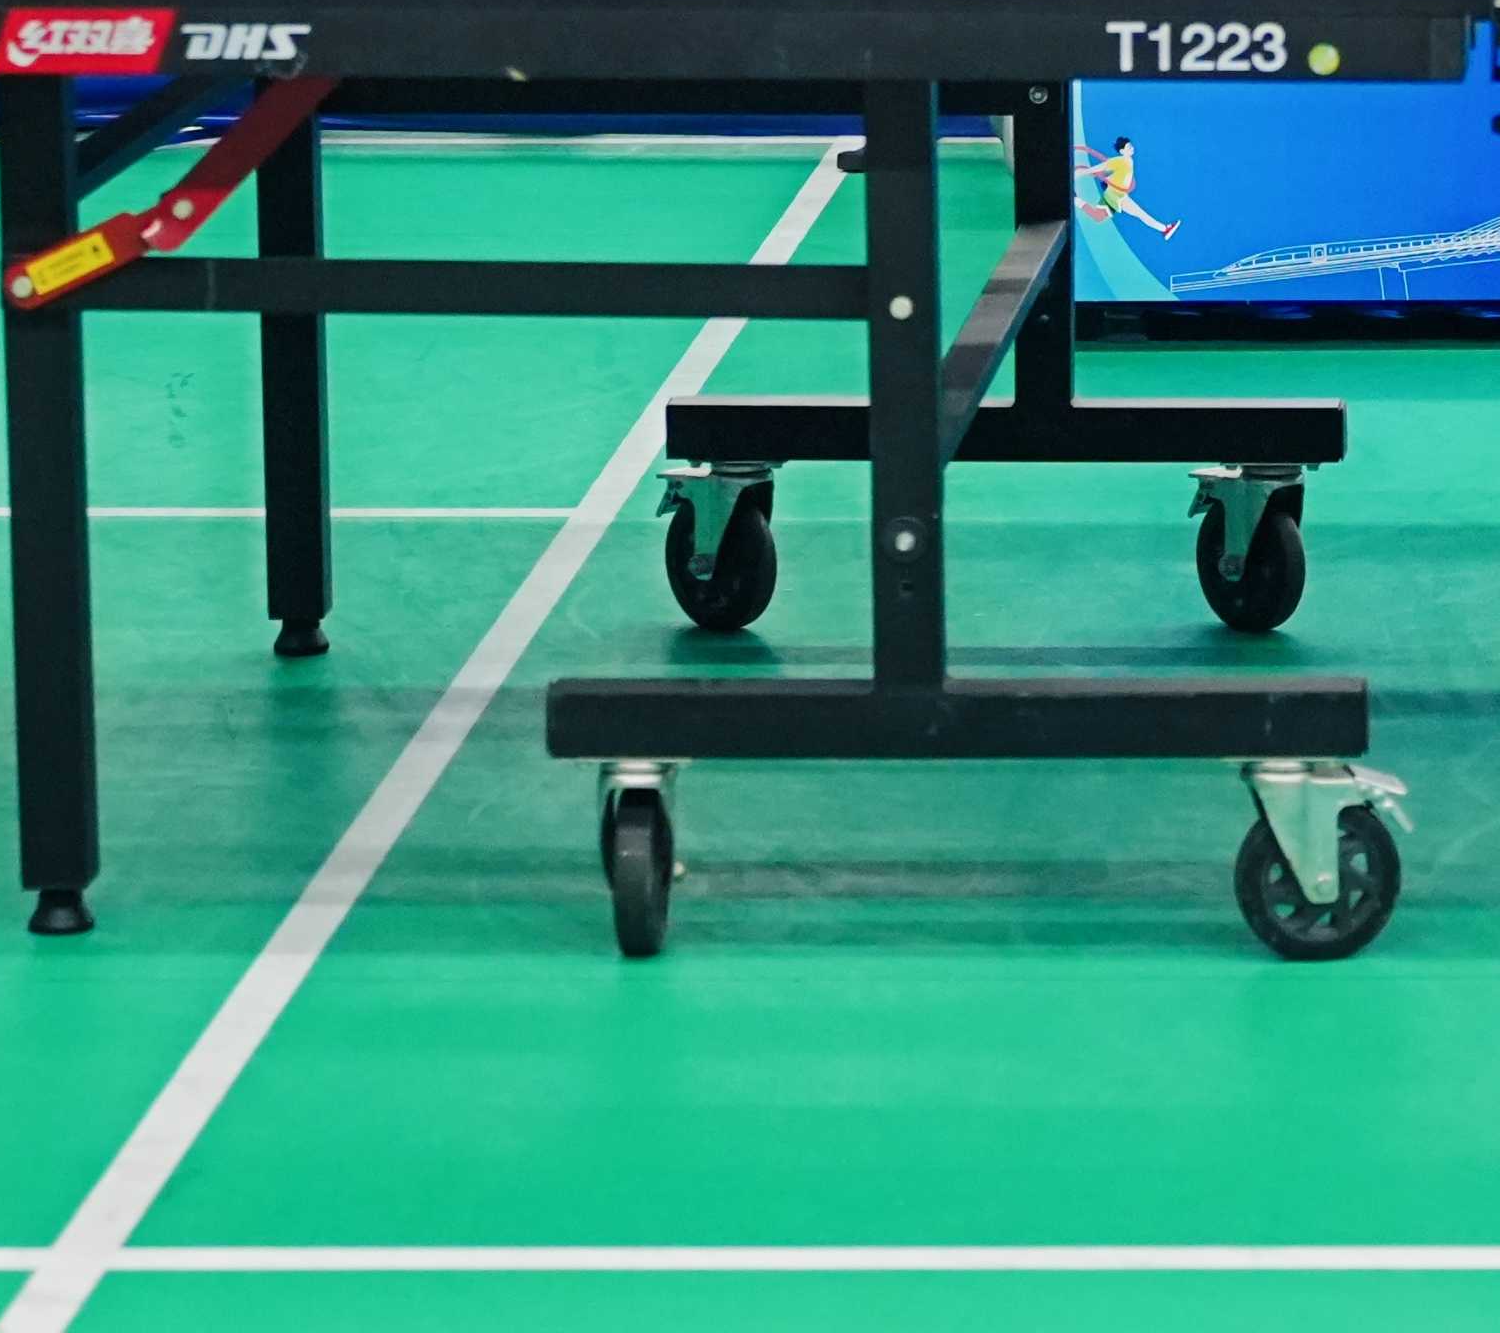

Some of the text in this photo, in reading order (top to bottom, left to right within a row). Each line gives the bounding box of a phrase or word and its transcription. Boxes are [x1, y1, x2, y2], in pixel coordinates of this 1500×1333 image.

[7, 15, 157, 68] 红双喜
[180, 23, 312, 61] DHS
[1105, 21, 1288, 73] T1223
